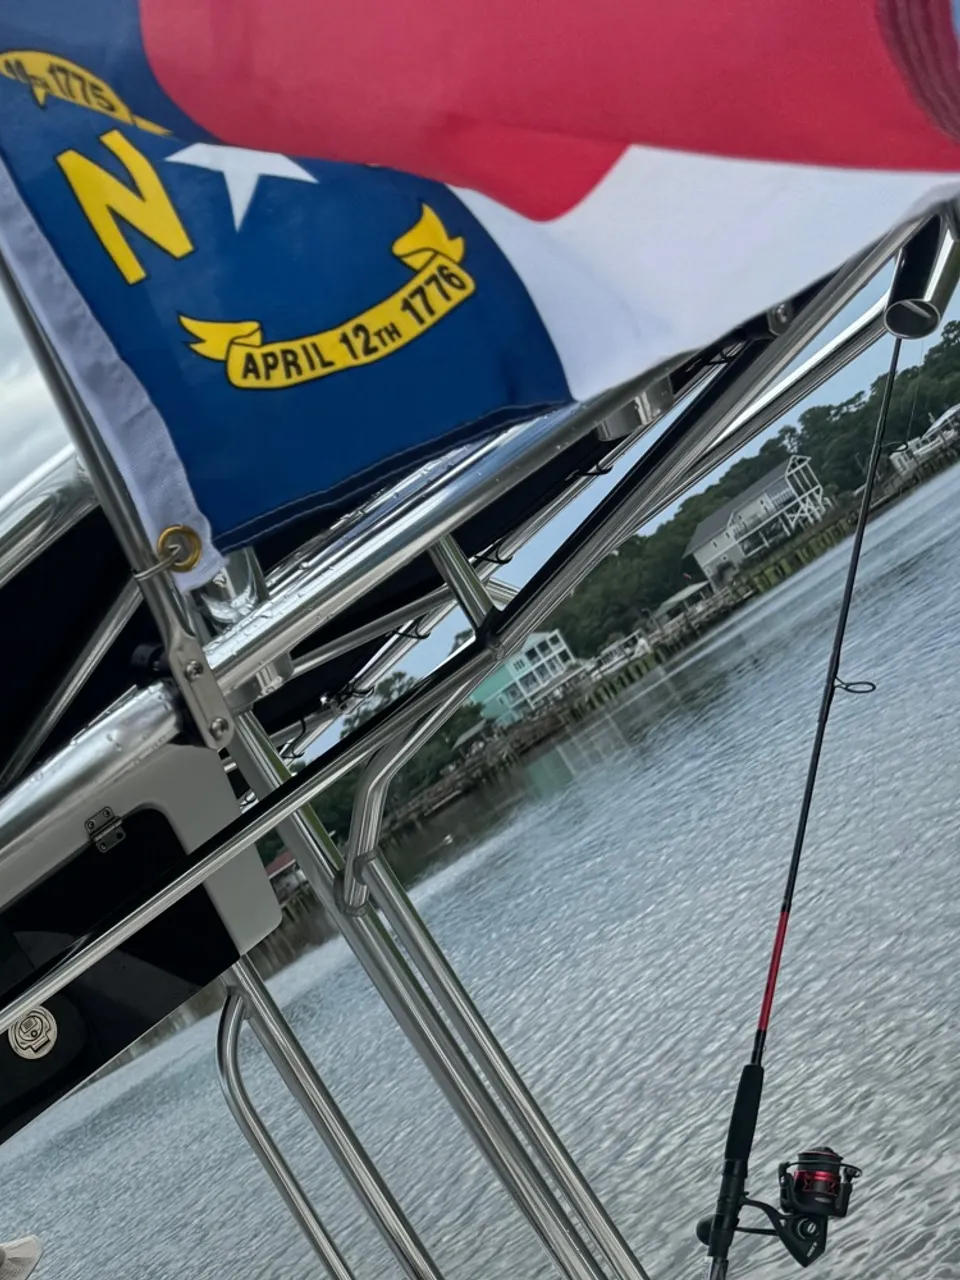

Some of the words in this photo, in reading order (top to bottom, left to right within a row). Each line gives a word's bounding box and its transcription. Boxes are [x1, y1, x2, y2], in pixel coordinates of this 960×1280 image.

[48, 62, 117, 112] 1775
[55, 129, 195, 286] N
[241, 341, 335, 381] APRIL
[339, 322, 403, 361] 12TH
[400, 263, 467, 328] 1776
